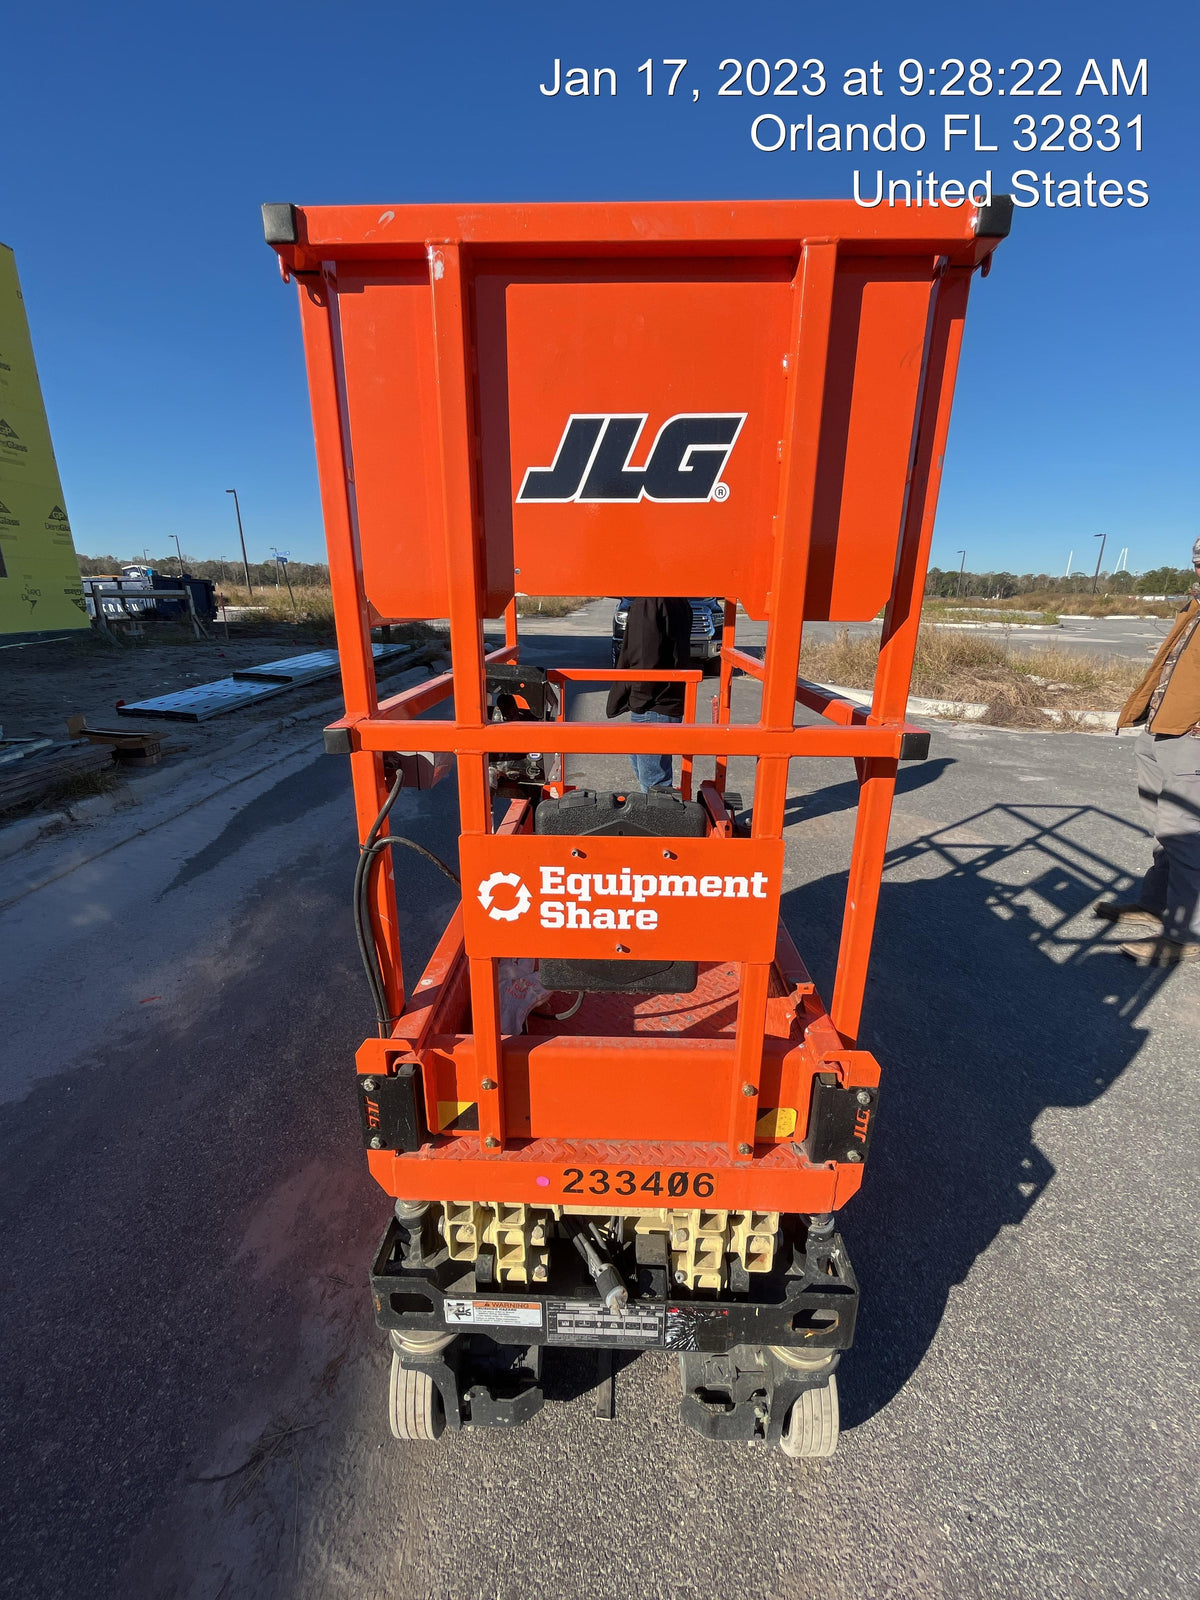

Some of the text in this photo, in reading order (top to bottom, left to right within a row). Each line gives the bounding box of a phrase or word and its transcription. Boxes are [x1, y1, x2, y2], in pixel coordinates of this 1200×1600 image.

[515, 413, 748, 503] JLG
[539, 866, 769, 903] Equipment
[539, 901, 658, 930] Share
[853, 1108, 871, 1144] JLG
